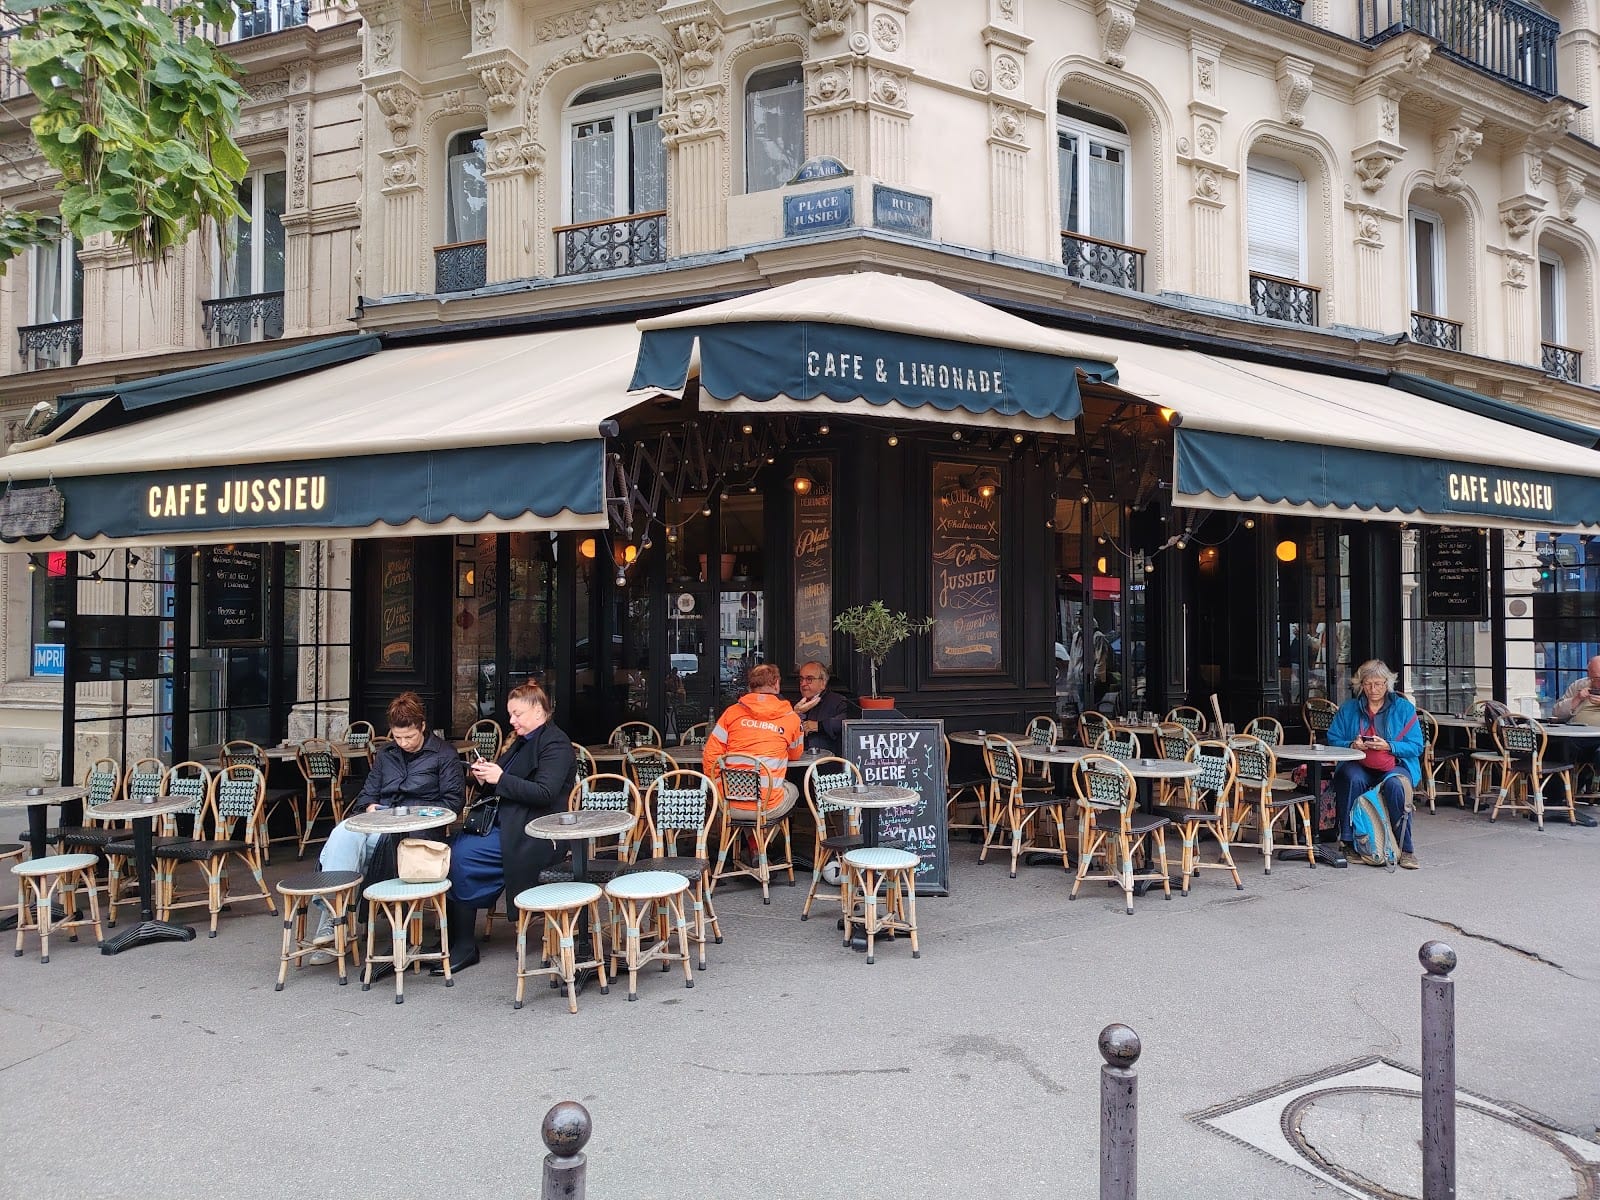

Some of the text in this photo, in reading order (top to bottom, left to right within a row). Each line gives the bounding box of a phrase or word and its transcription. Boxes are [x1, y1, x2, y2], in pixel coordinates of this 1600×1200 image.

[799, 196, 839, 212] PLACE
[892, 198, 914, 213] RUE
[793, 208, 842, 226] JUSSIEU
[806, 351, 1004, 394] CAFE & LIMONADE
[148, 476, 326, 518] CAFE JUSSIEU
[1449, 473, 1553, 511] CAFE JUSSIEU
[939, 569, 996, 608] JUSSIEU
[740, 718, 778, 733] COLIBRI
[860, 732, 920, 750] HAPPY
[870, 746, 909, 760] HOUR
[865, 765, 907, 782] BIERE
